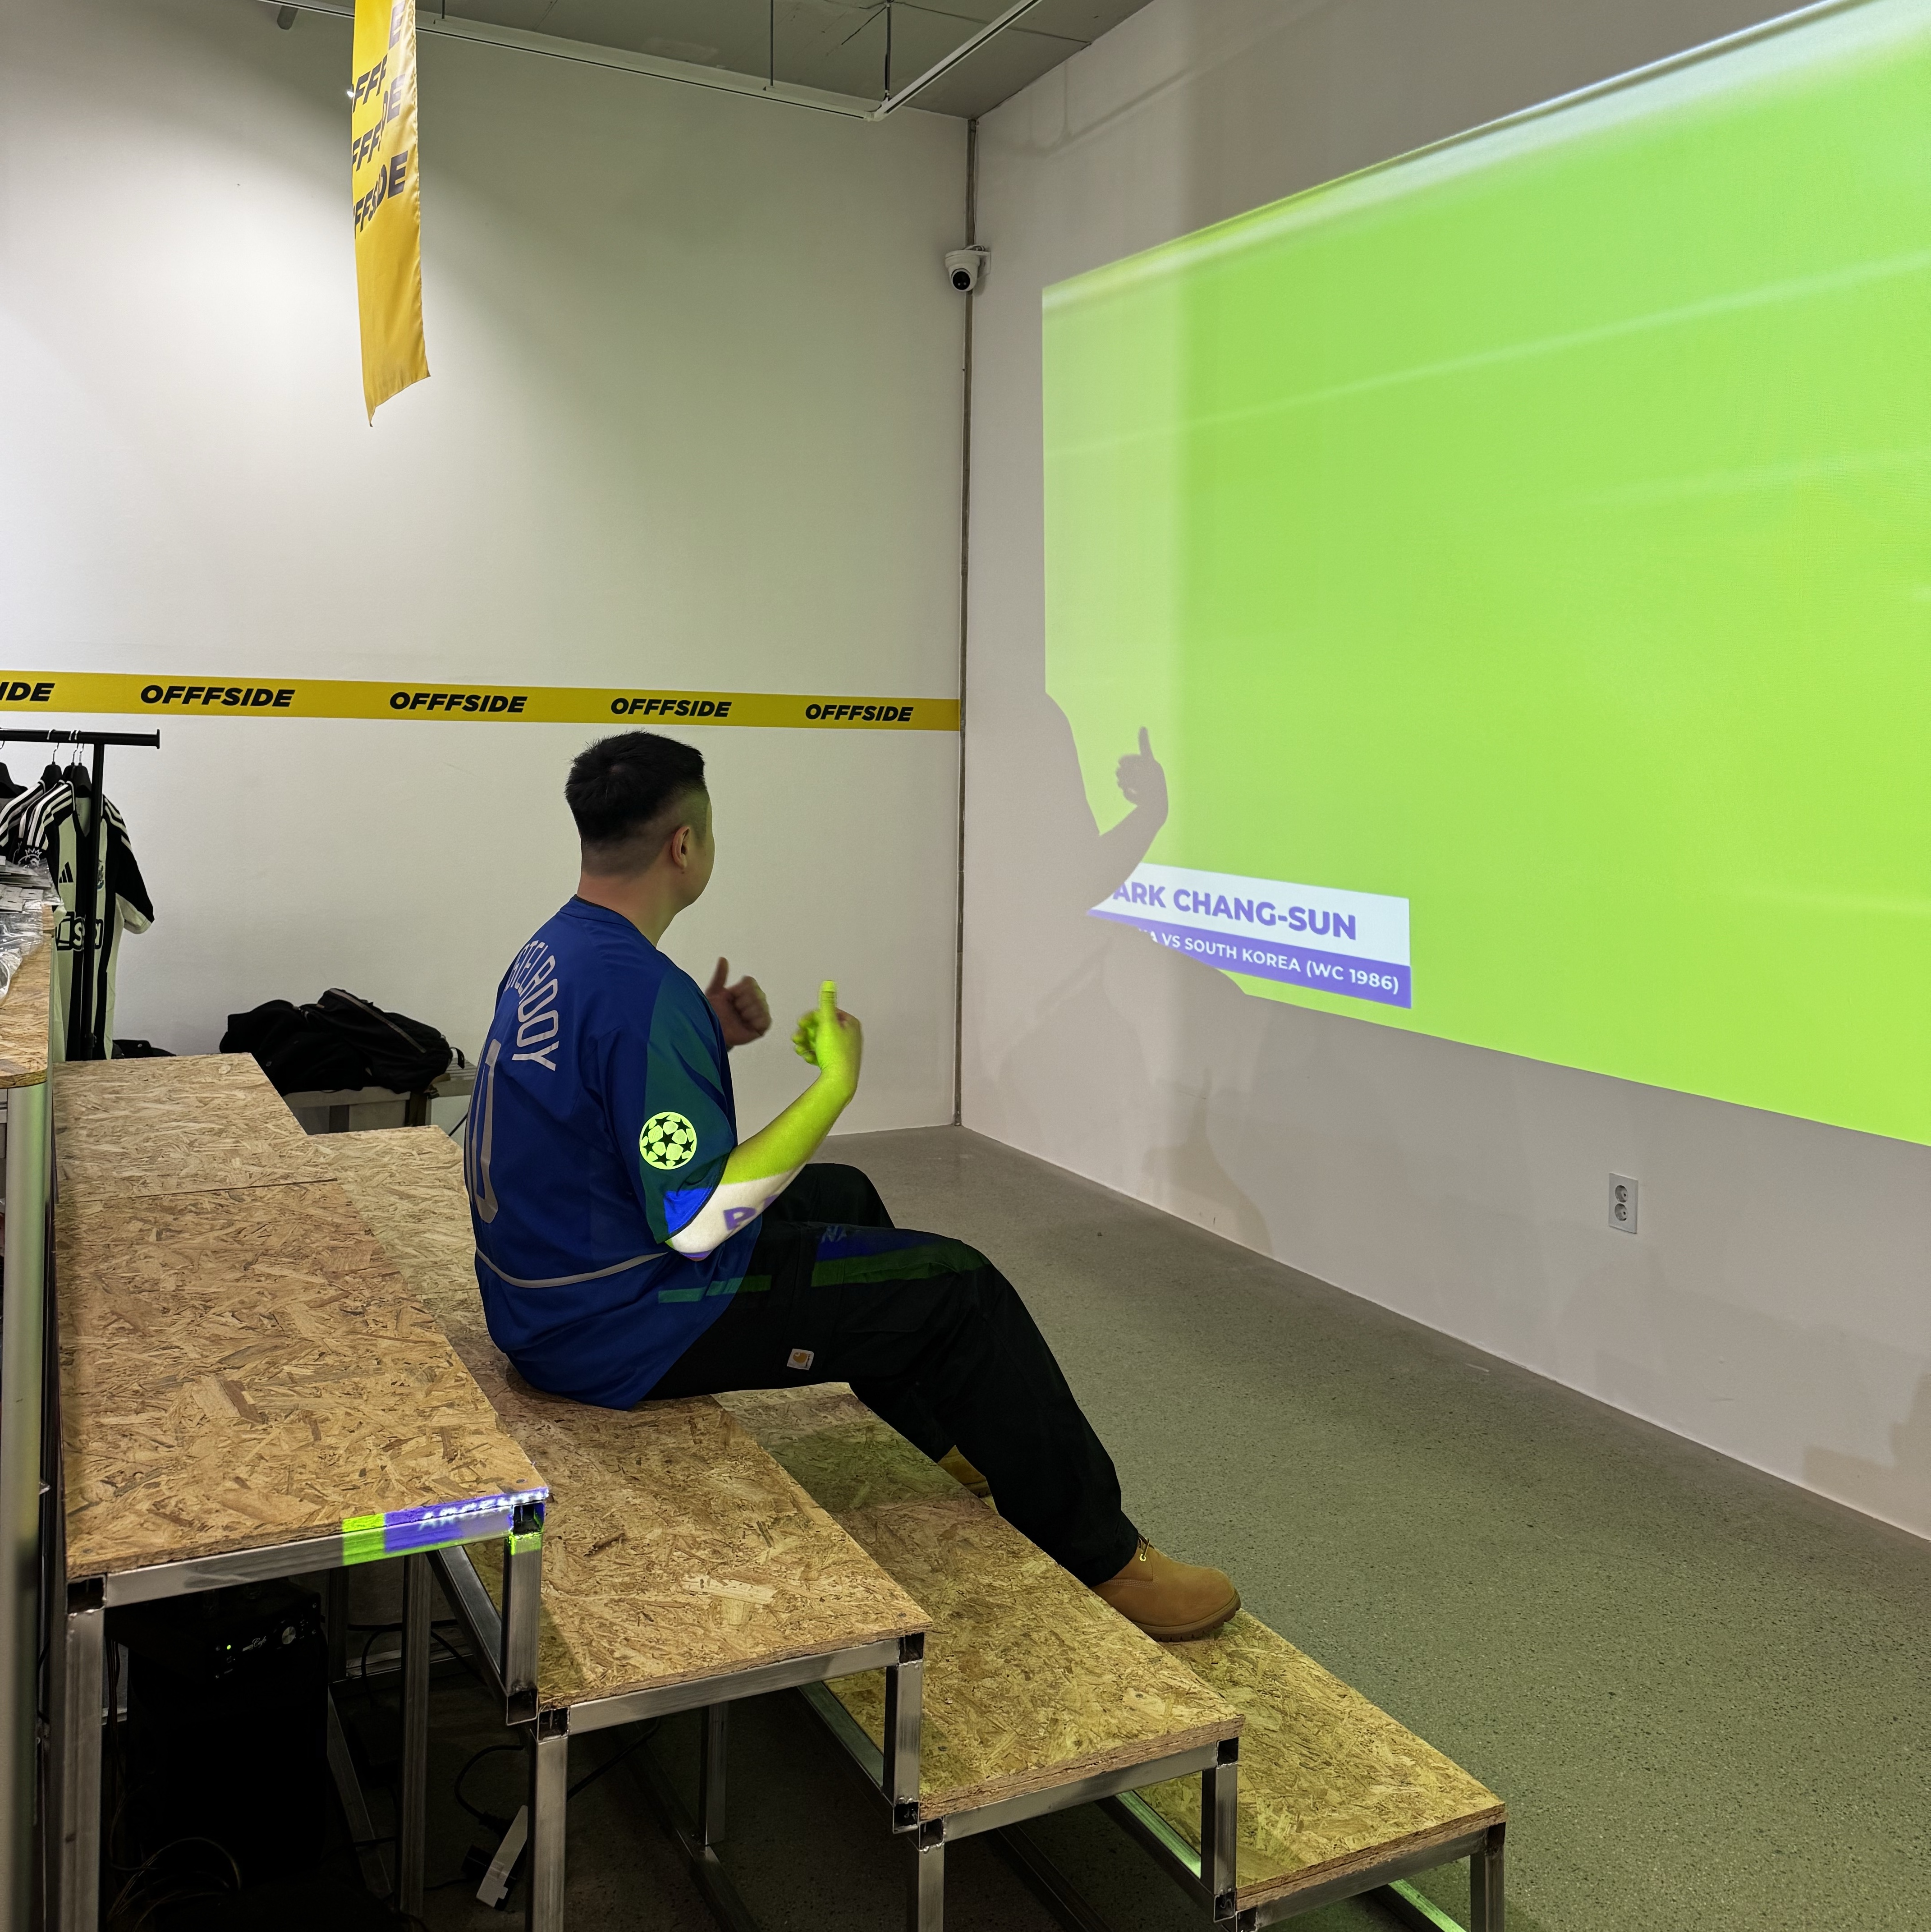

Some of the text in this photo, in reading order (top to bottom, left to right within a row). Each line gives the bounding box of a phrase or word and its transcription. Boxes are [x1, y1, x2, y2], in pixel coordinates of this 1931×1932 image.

[141, 684, 296, 707] OFFFSIDE
[390, 692, 528, 713] OFFFSIDE
[611, 698, 732, 717] OFFFSIDE
[805, 704, 914, 722] OFFFSIDE
[1112, 881, 1356, 940] ARK CHANG-SUN
[1162, 932, 1180, 948] VS
[1185, 937, 1237, 959] SOUTH
[1243, 948, 1301, 972] KOREA
[1307, 960, 1344, 980] (WC
[1349, 968, 1399, 995] 1986)
